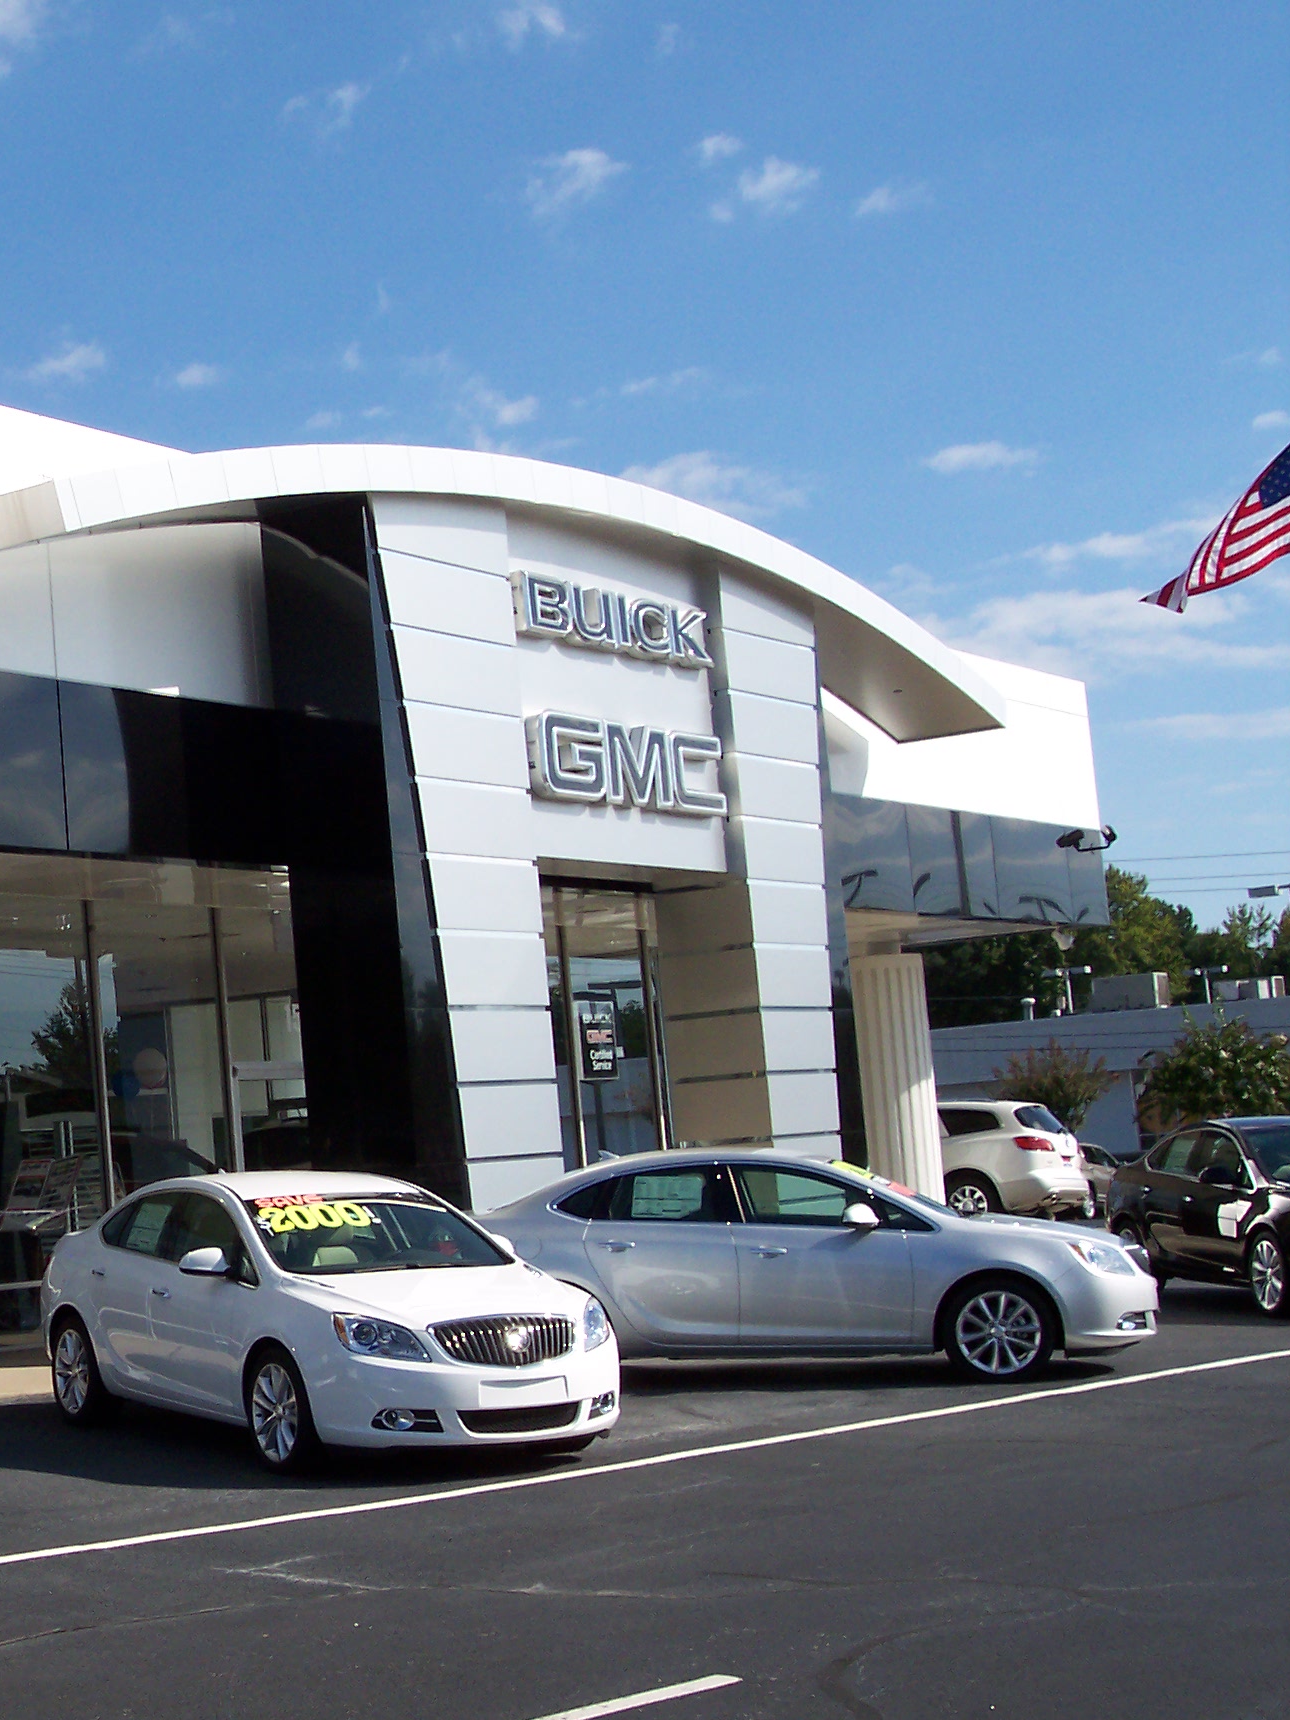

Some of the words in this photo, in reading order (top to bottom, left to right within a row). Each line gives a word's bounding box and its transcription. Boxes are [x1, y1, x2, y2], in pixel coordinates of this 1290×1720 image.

[523, 570, 714, 669] BUICK
[536, 708, 728, 815] GMC
[582, 1013, 612, 1024] BUICK
[587, 1030, 613, 1044] GMC
[589, 1048, 614, 1060] Certified
[592, 1061, 612, 1071] Service
[254, 1194, 324, 1208] SAVE
